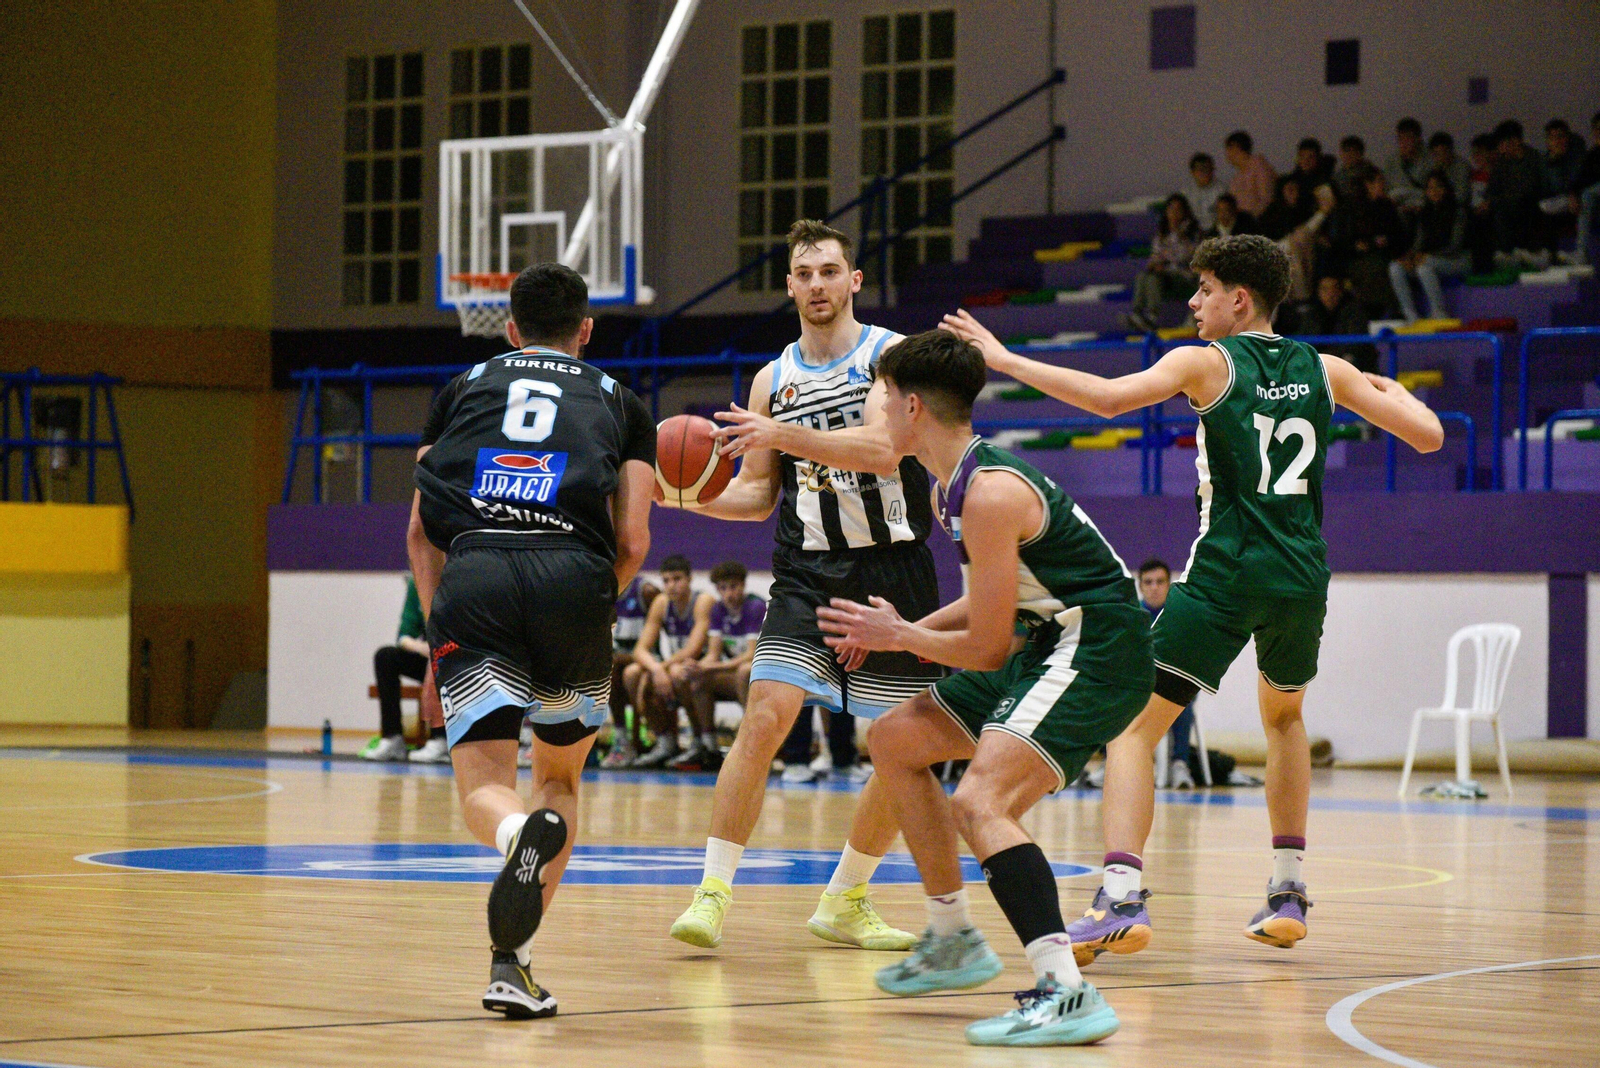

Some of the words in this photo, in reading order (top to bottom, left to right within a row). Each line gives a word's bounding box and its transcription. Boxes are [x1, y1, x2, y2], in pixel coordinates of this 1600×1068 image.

[501, 378, 563, 443] 6
[1253, 412, 1317, 495] 12
[887, 499, 903, 525] 4
